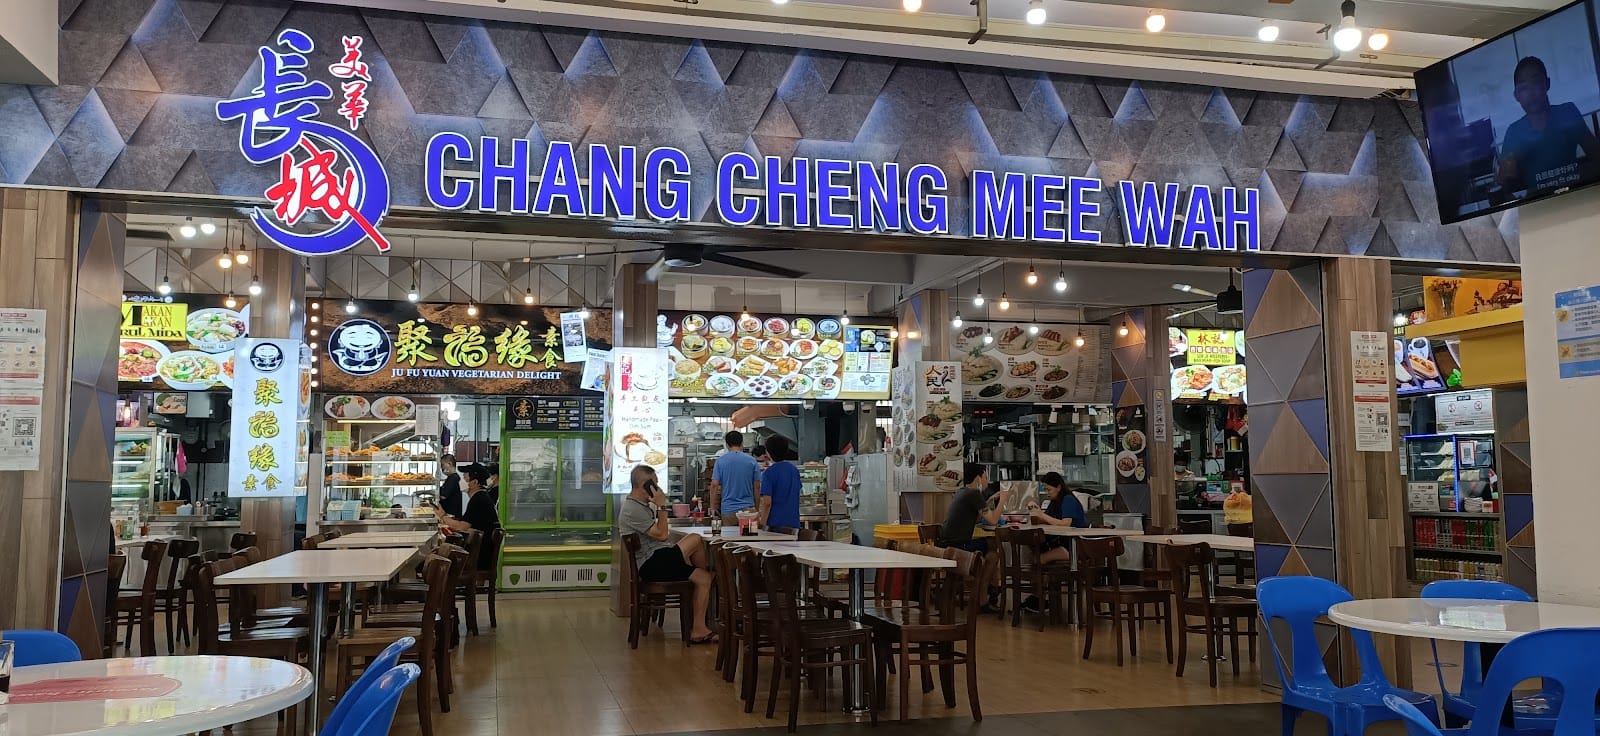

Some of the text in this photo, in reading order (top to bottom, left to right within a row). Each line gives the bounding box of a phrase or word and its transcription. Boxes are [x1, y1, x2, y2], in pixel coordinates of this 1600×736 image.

[424, 131, 1261, 252] CHANG CHENG MEE WAH
[539, 326, 563, 369] 素食
[391, 368, 562, 380] JU FU YUAN VEGETARIAN DELIGHT
